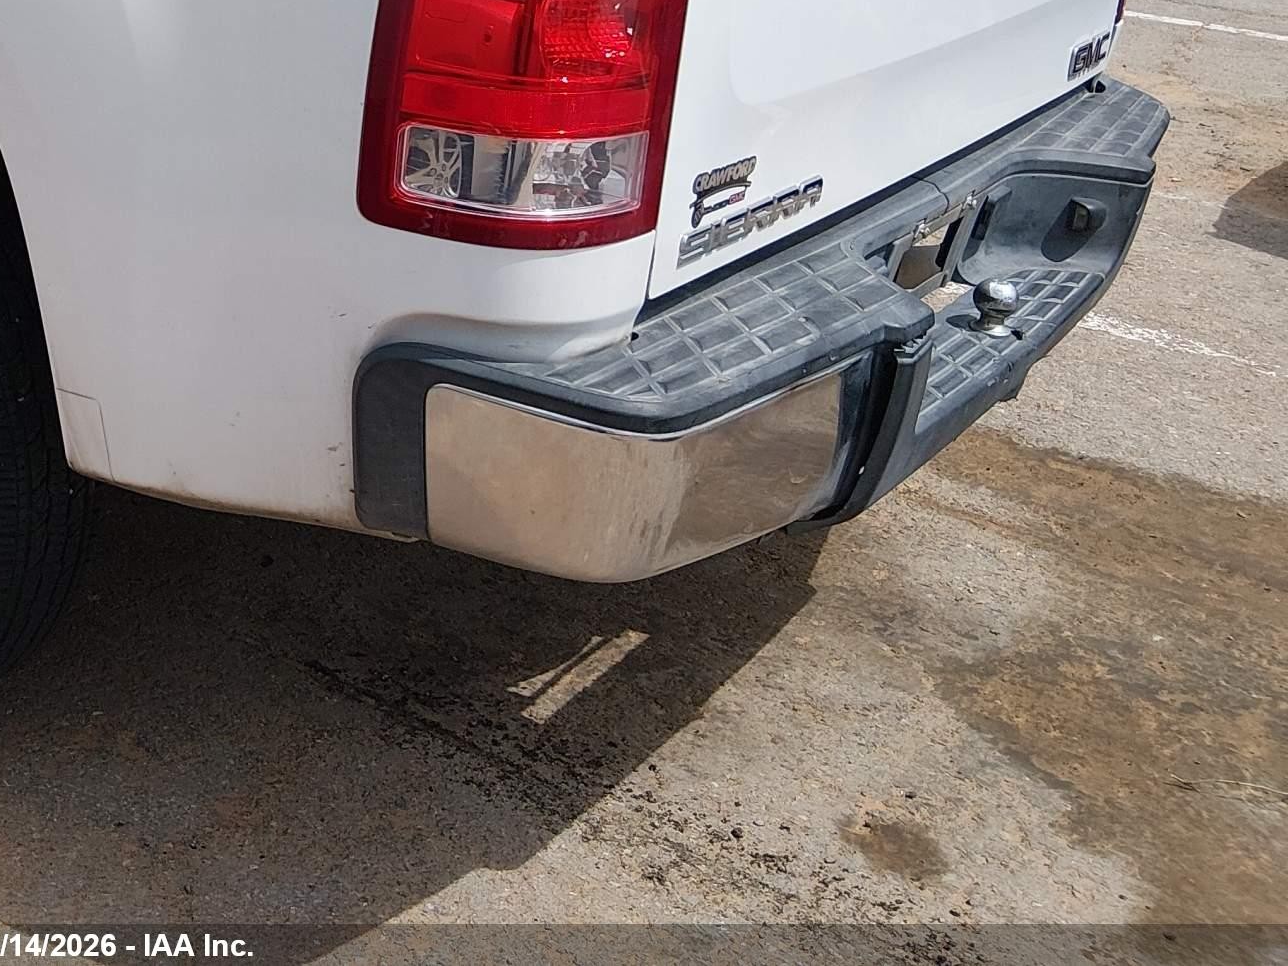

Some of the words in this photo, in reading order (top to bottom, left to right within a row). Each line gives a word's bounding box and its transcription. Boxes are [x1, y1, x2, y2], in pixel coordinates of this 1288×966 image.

[1068, 32, 1110, 80] GMC
[694, 156, 756, 193] CRAWFORD
[677, 175, 824, 269] SIERRA
